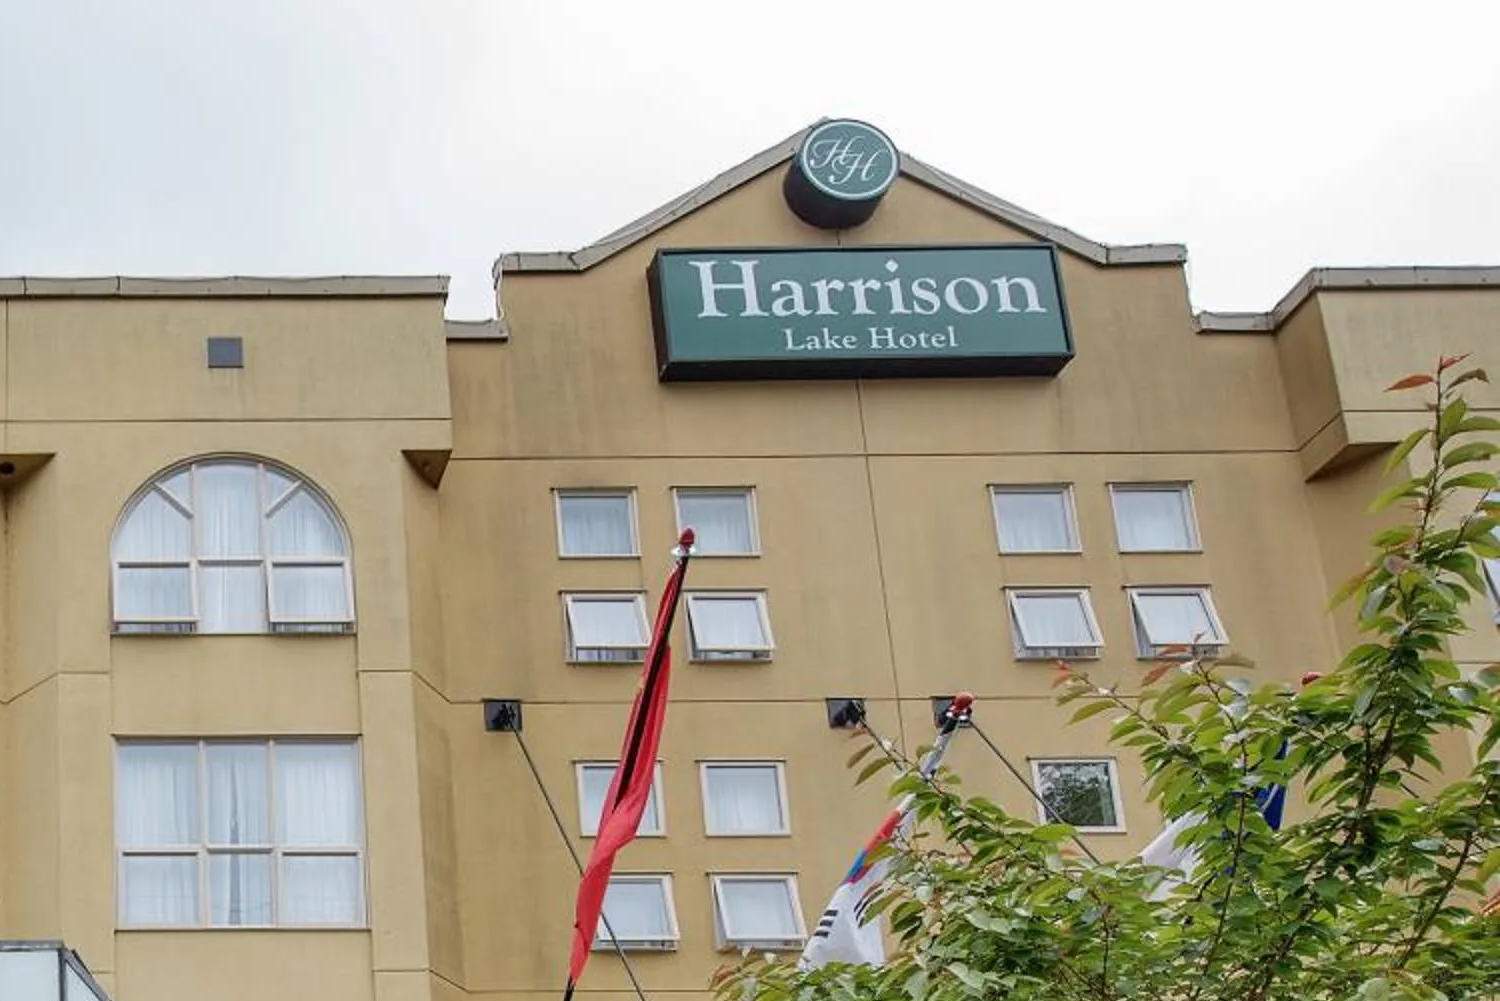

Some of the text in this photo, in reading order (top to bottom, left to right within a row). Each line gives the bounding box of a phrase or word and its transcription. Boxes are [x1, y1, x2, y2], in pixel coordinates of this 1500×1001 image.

[688, 258, 1047, 319] Harrison
[783, 326, 958, 352] Lake Hotel
